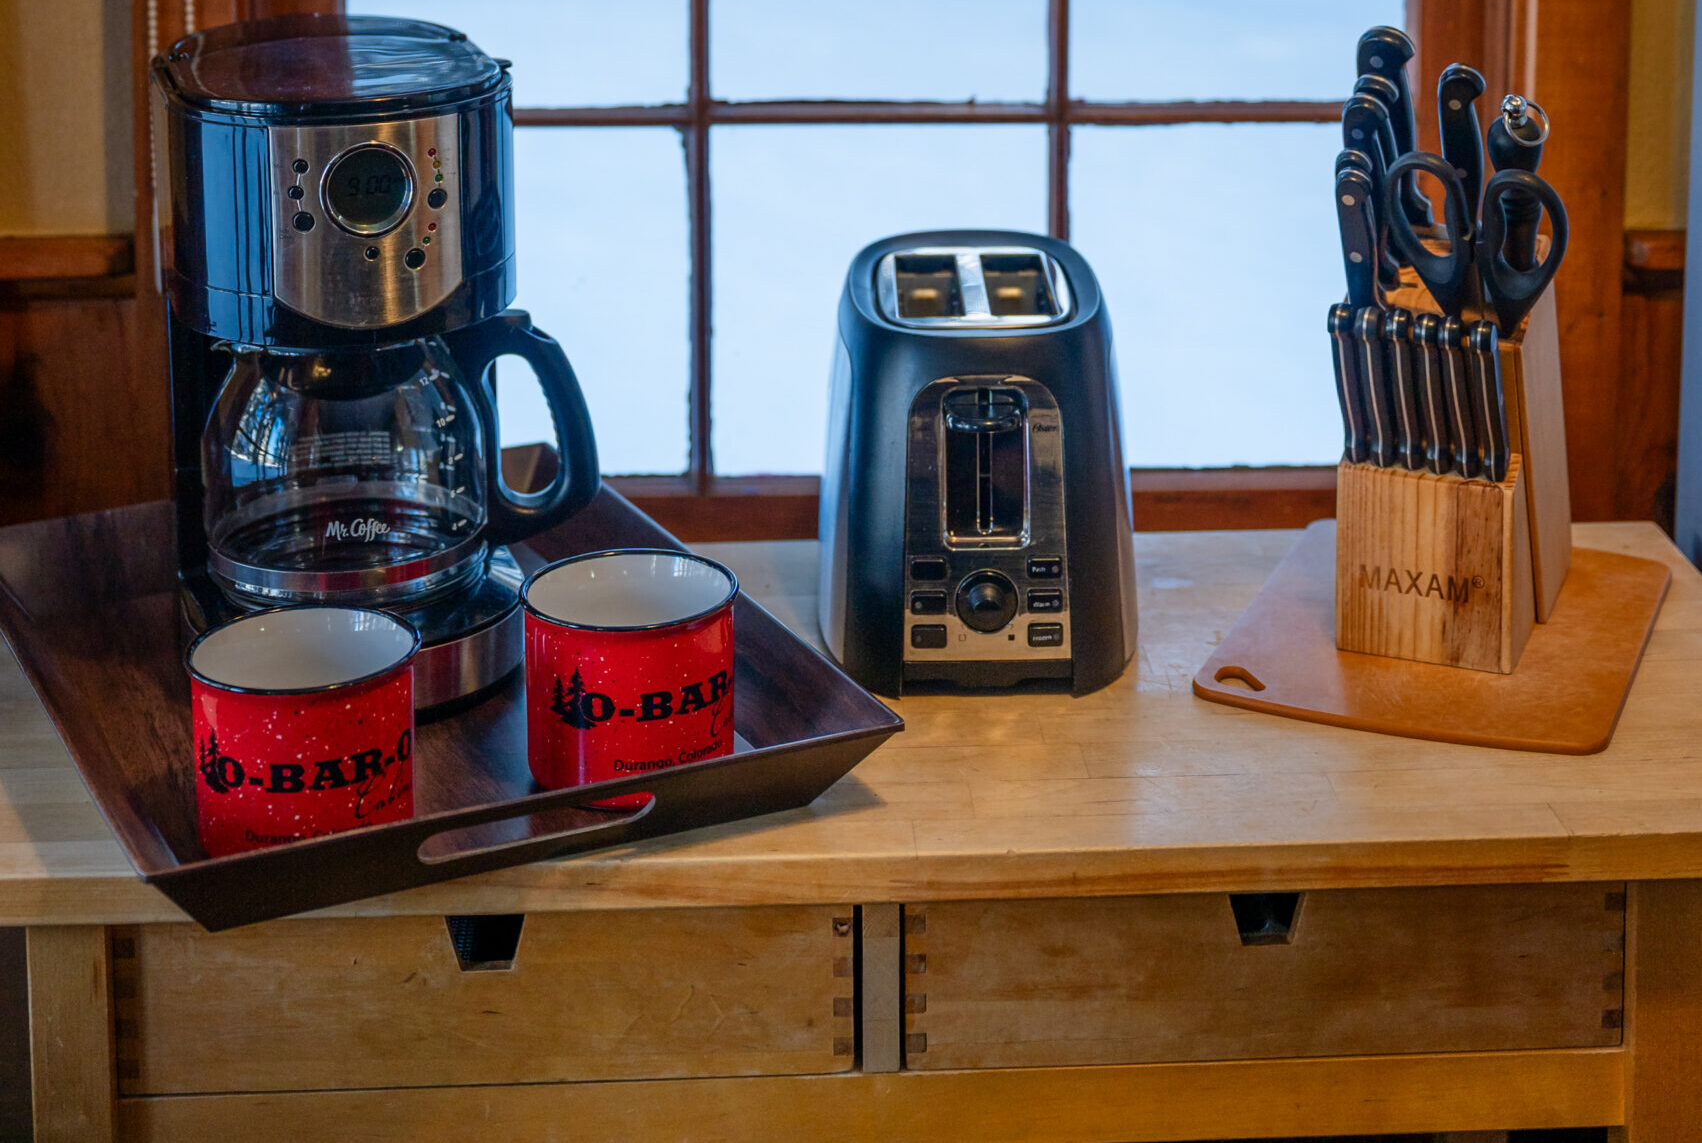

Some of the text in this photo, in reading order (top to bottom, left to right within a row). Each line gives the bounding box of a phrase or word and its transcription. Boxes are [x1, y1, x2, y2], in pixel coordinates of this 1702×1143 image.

[419, 377, 430, 386] 12
[436, 417, 446, 428] 10
[325, 518, 391, 543] Mr. Coffee
[678, 739, 722, 763] Colorado
